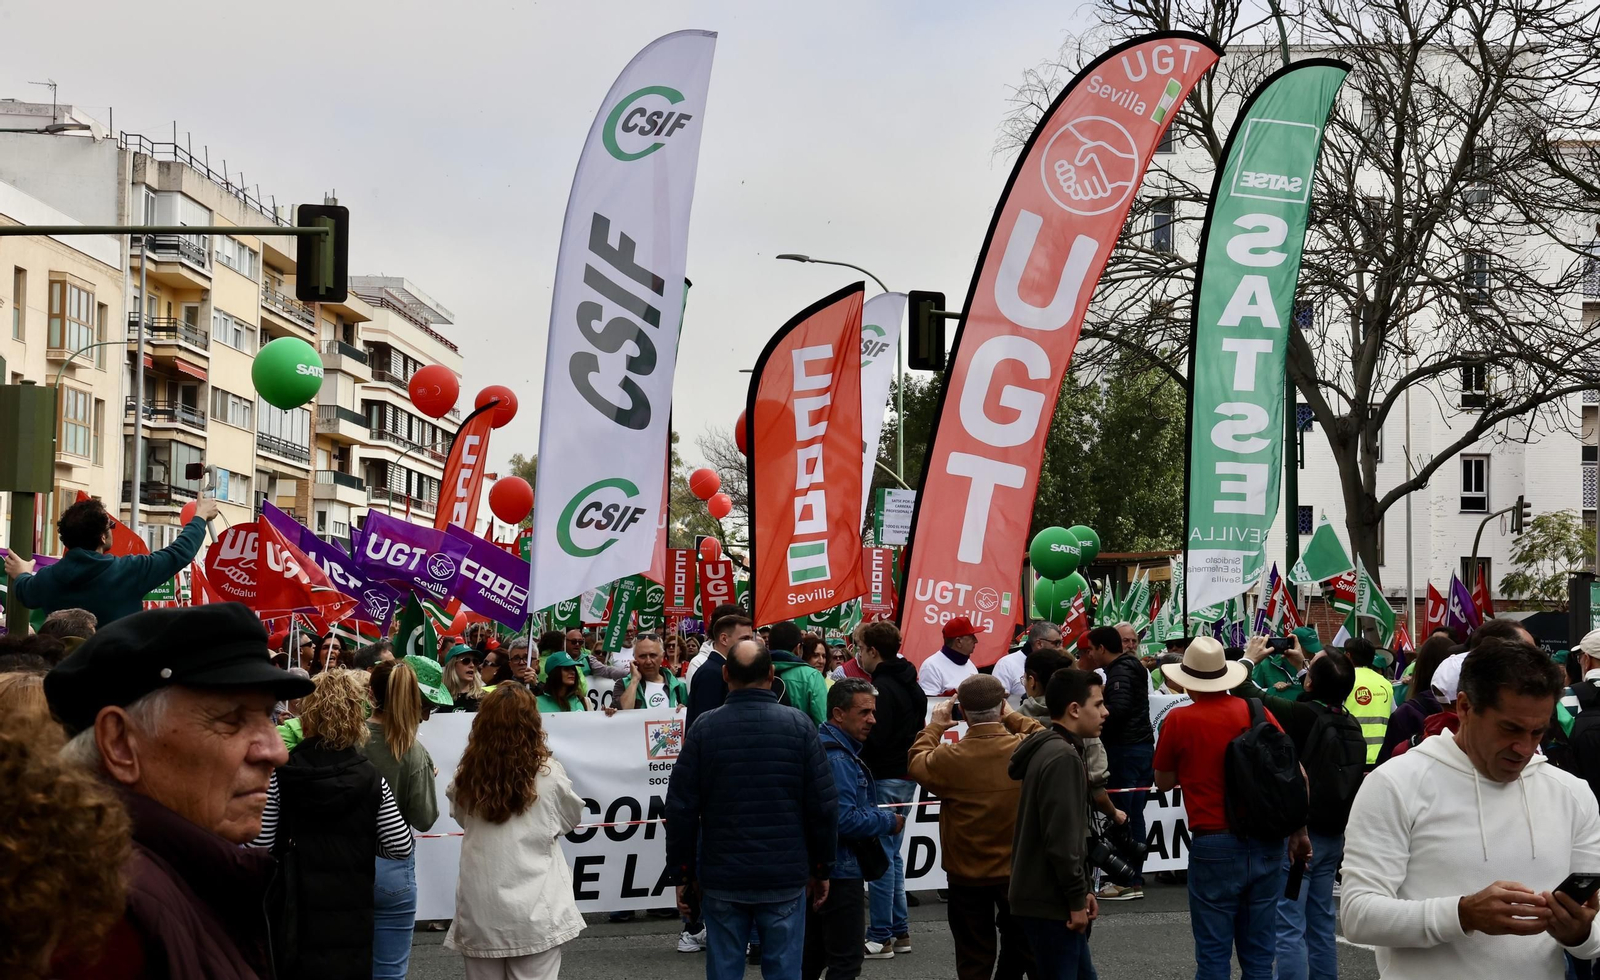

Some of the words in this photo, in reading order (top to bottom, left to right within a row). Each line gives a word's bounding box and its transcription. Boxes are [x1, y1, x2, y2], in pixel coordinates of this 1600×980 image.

[1121, 44, 1200, 82] UGT
[1086, 75, 1147, 116] Sevilla
[621, 107, 693, 137] CSIF
[569, 211, 665, 431] CSIF
[861, 338, 890, 358] SIF
[946, 208, 1099, 566] UGT
[453, 435, 480, 530] CCO
[575, 501, 647, 533] CSIF
[219, 529, 258, 559] UG
[366, 532, 427, 571] UGT
[1050, 543, 1081, 556] SATSE
[674, 550, 687, 595] CCOO
[705, 563, 729, 607] UGT
[872, 549, 883, 593] CCOO
[478, 587, 521, 615] Andalucía
[647, 592, 665, 604] CSI
[787, 588, 835, 606] Sevilla
[914, 578, 972, 607] UGT
[1336, 580, 1356, 594] Sevill
[559, 600, 577, 612] CSIF
[609, 591, 630, 648] SATSE
[923, 604, 994, 633] Sella
[649, 762, 674, 772] feder
[649, 776, 671, 786] soci
